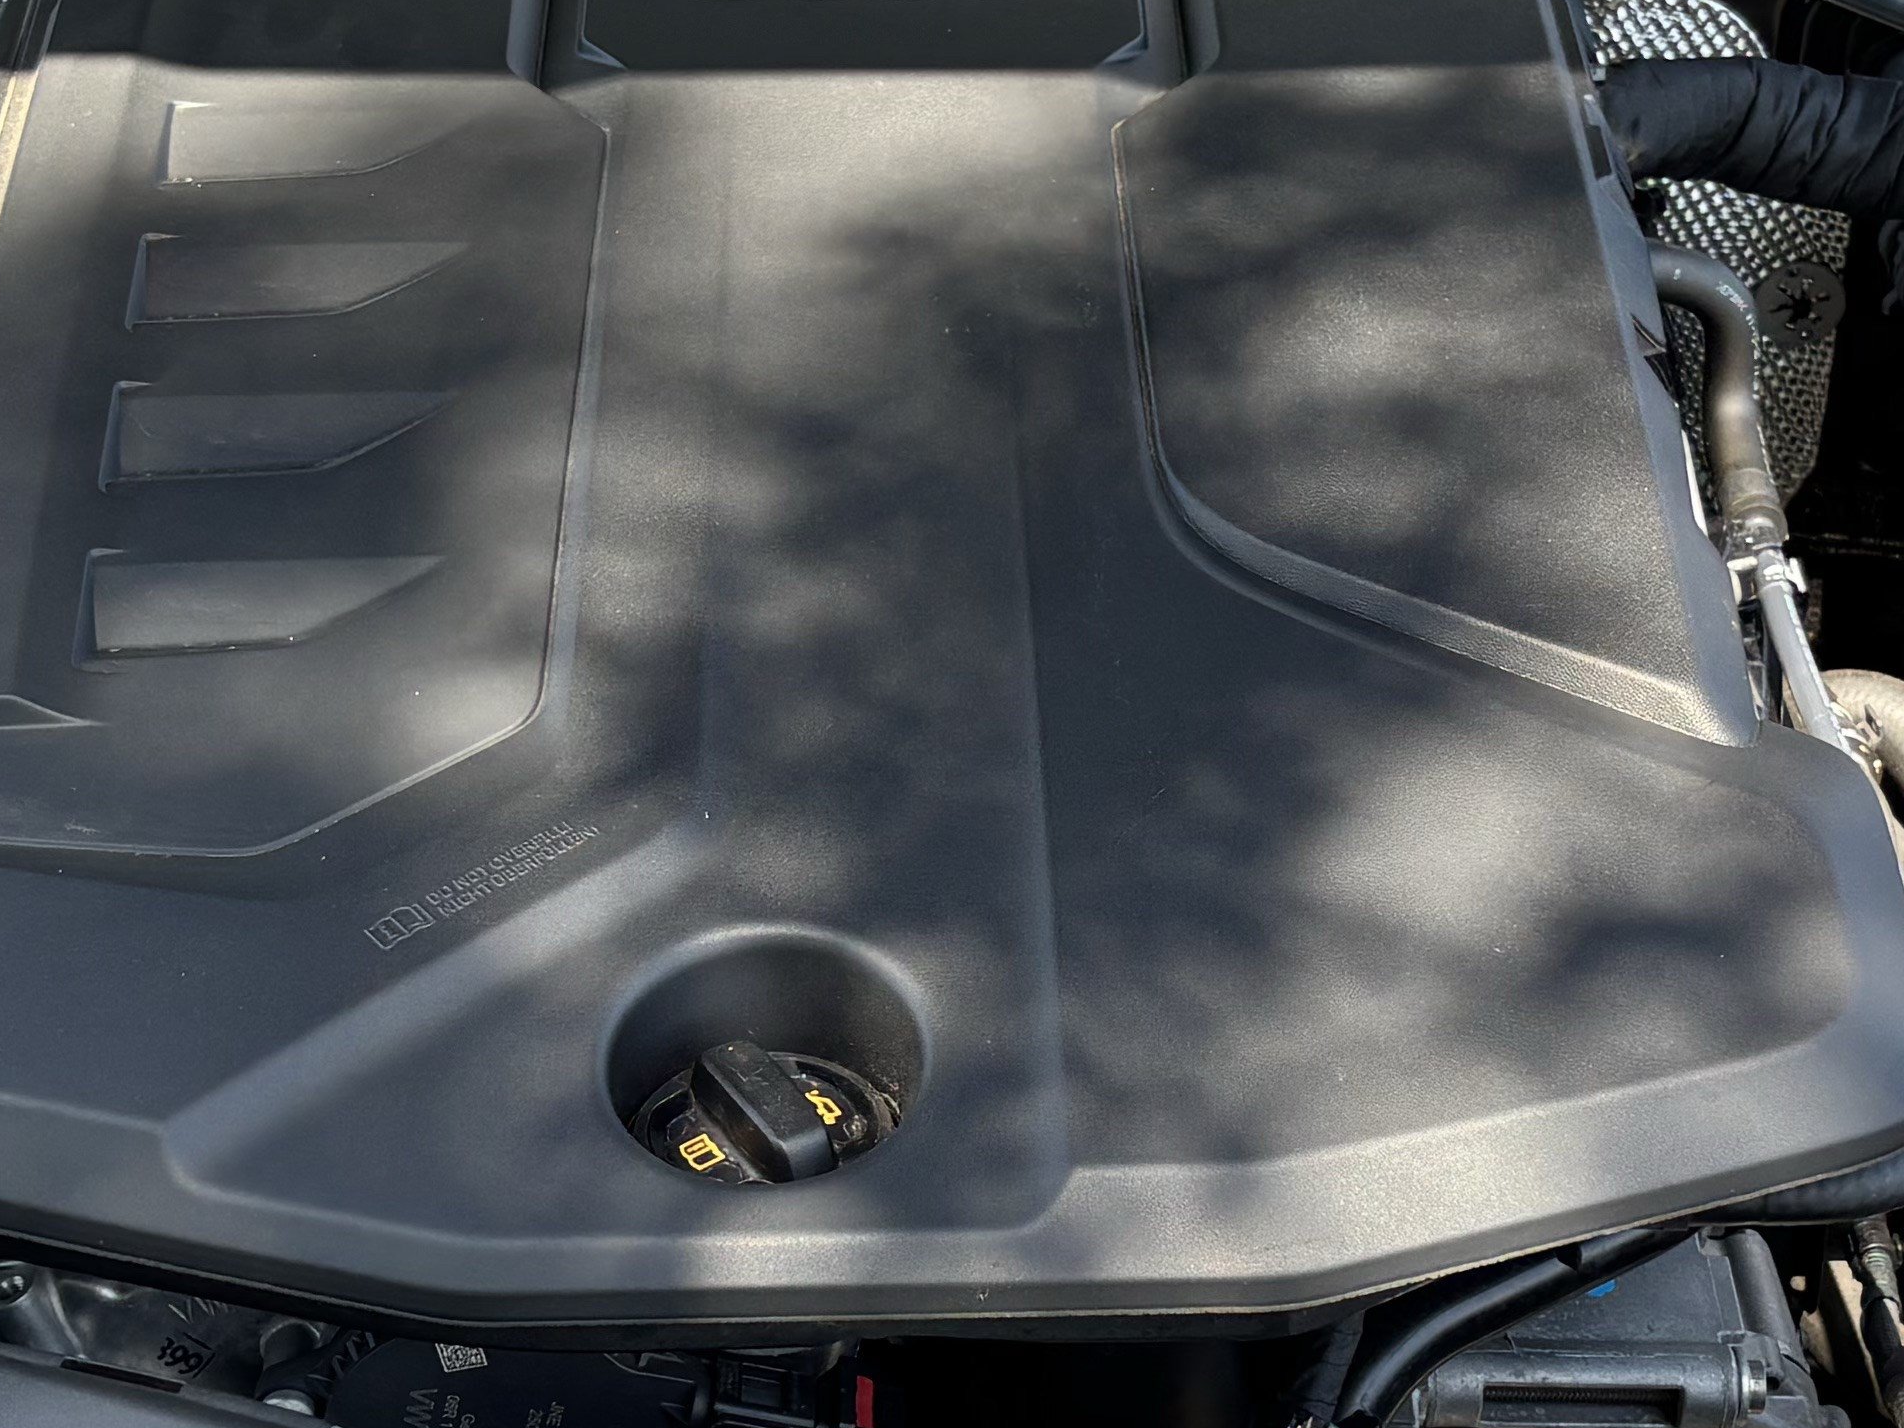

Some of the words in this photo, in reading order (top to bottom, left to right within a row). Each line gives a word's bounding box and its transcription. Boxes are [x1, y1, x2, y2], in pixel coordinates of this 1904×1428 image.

[426, 886, 453, 905] DO
[453, 867, 488, 890] NOT
[438, 882, 492, 917] NICHT
[403, 1389, 438, 1428] VW
